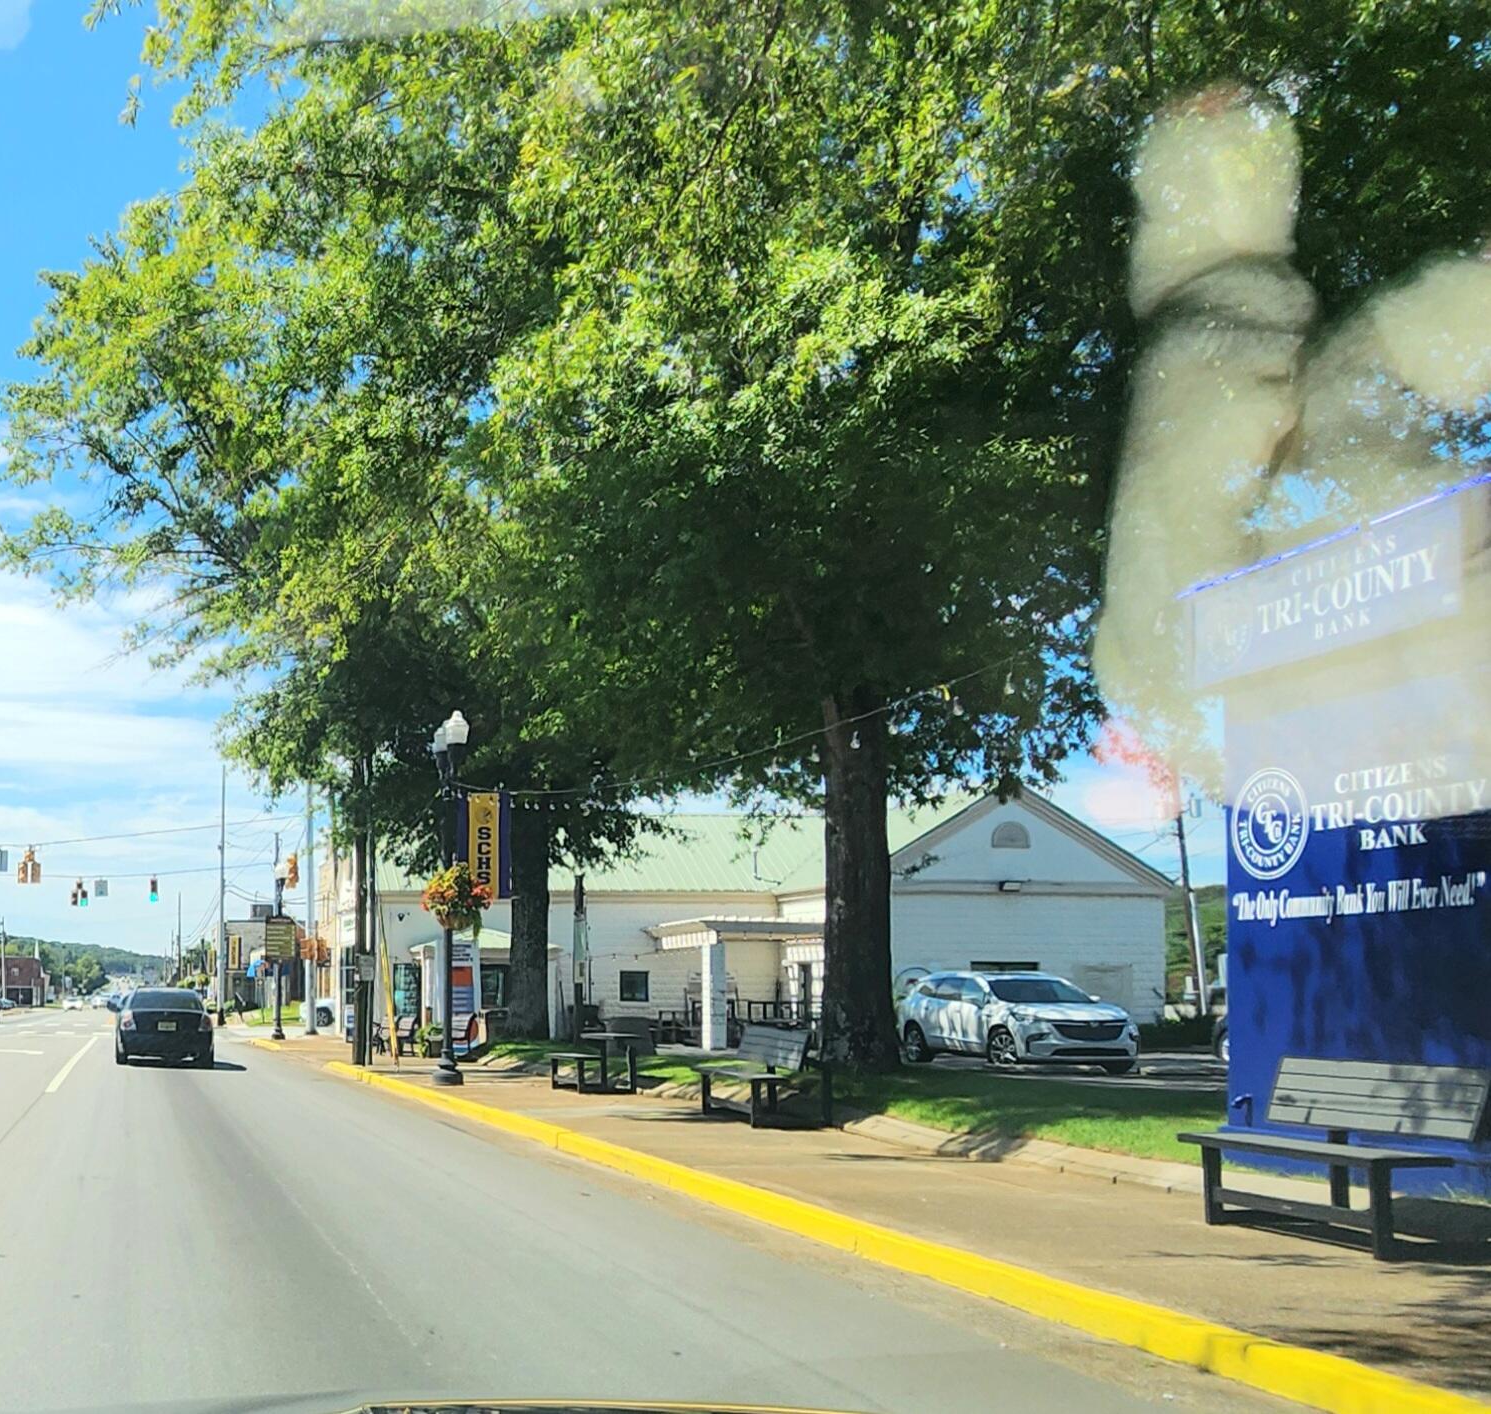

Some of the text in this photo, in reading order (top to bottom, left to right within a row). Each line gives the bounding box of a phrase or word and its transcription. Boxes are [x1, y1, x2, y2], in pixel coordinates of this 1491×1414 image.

[1258, 542, 1441, 634] TRI-COUNTY
[1314, 608, 1371, 640] BANK
[1334, 755, 1447, 794] CITIZENS
[1312, 779, 1487, 832] TRI-COUNTY
[477, 826, 492, 885] SCHS
[1359, 822, 1428, 850] BANK
[1256, 889, 1278, 927] Only
[1279, 887, 1335, 924] Community
[1336, 884, 1364, 916] Bank
[1365, 882, 1385, 914] You
[1387, 879, 1410, 912] Will
[1411, 878, 1439, 910] Ever
